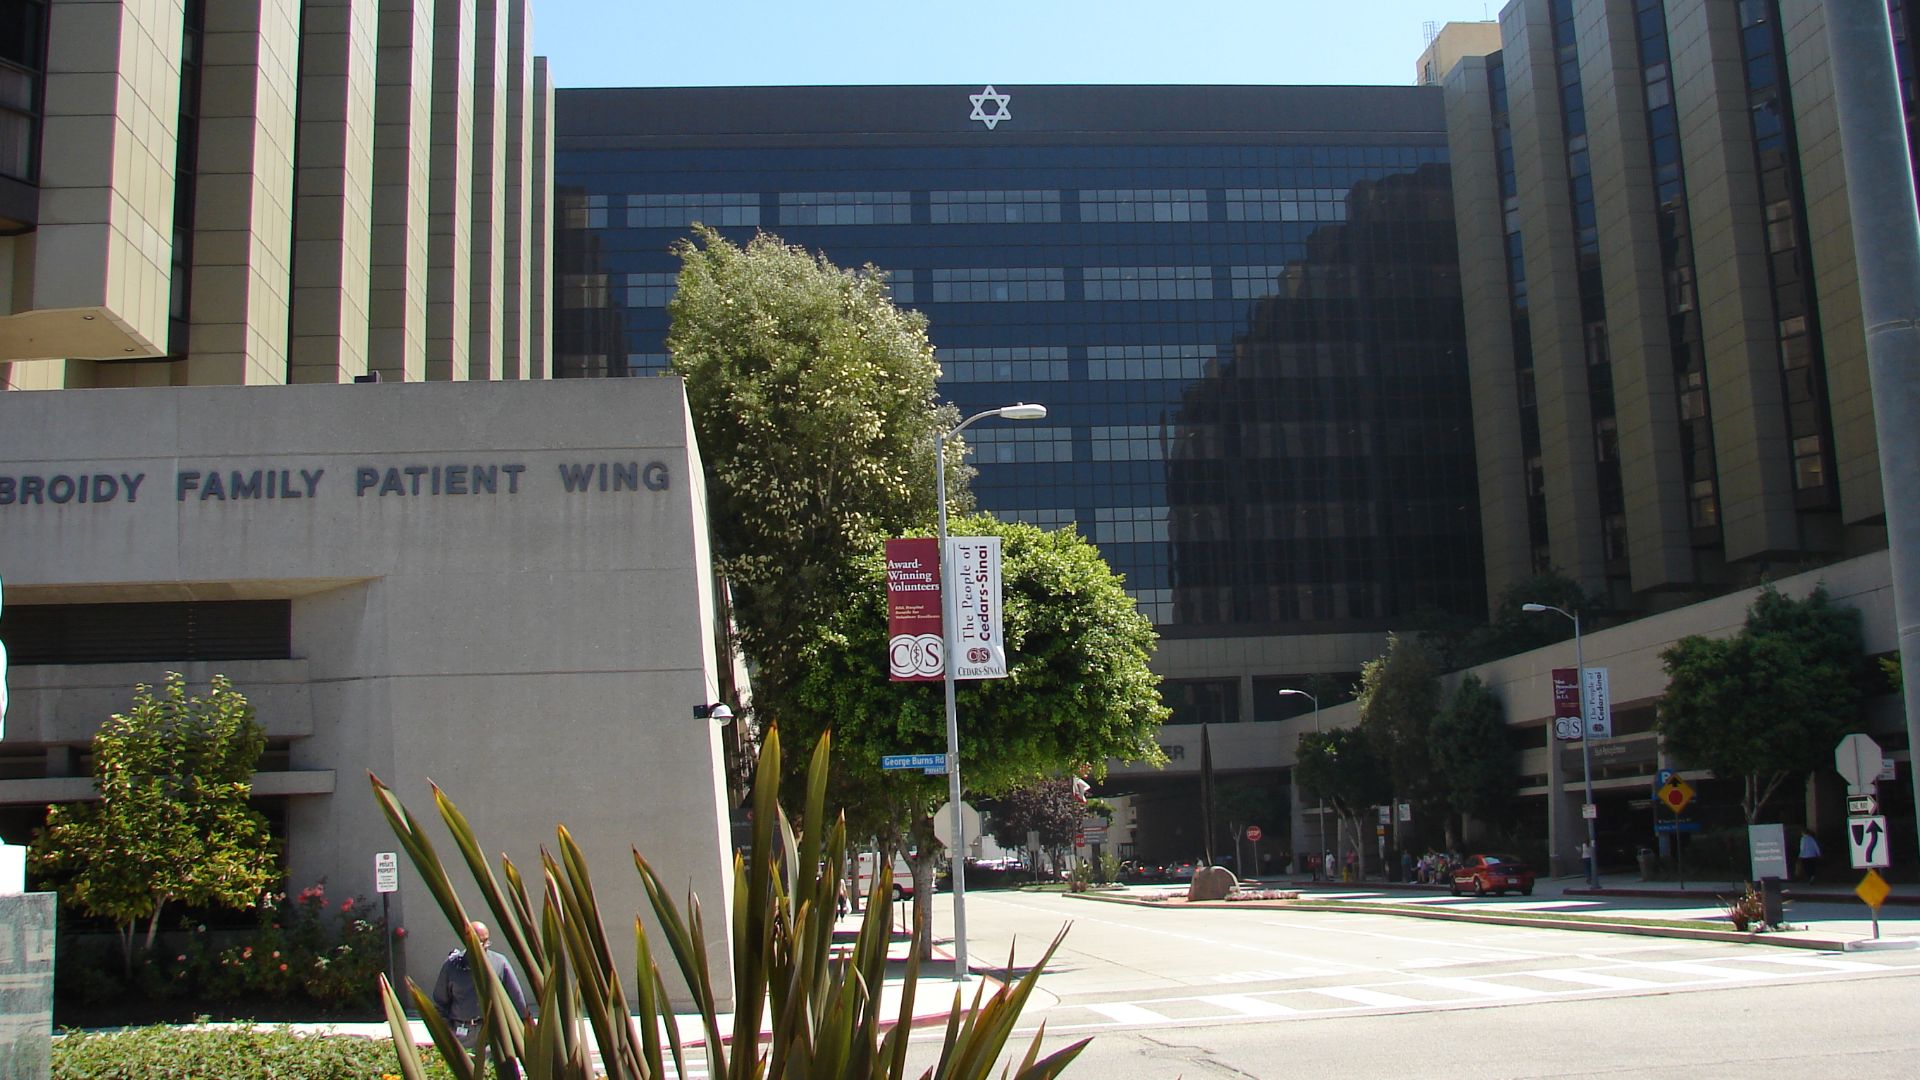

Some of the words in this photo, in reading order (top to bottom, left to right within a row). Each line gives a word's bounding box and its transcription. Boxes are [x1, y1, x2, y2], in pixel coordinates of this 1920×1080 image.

[0, 474, 146, 505] BROIDY
[177, 470, 326, 501] FAMILY
[356, 464, 526, 497] PATIENT
[558, 461, 670, 492] WING
[958, 544, 971, 559] of
[887, 558, 923, 569] Award-
[888, 570, 933, 583] Winning
[888, 581, 940, 592] Volunteers
[959, 565, 974, 609] People
[975, 545, 991, 642] Cedars-Sinai
[962, 615, 975, 642] The
[884, 757, 911, 767] George
[912, 756, 934, 765] Burns
[935, 756, 945, 764] Rd
